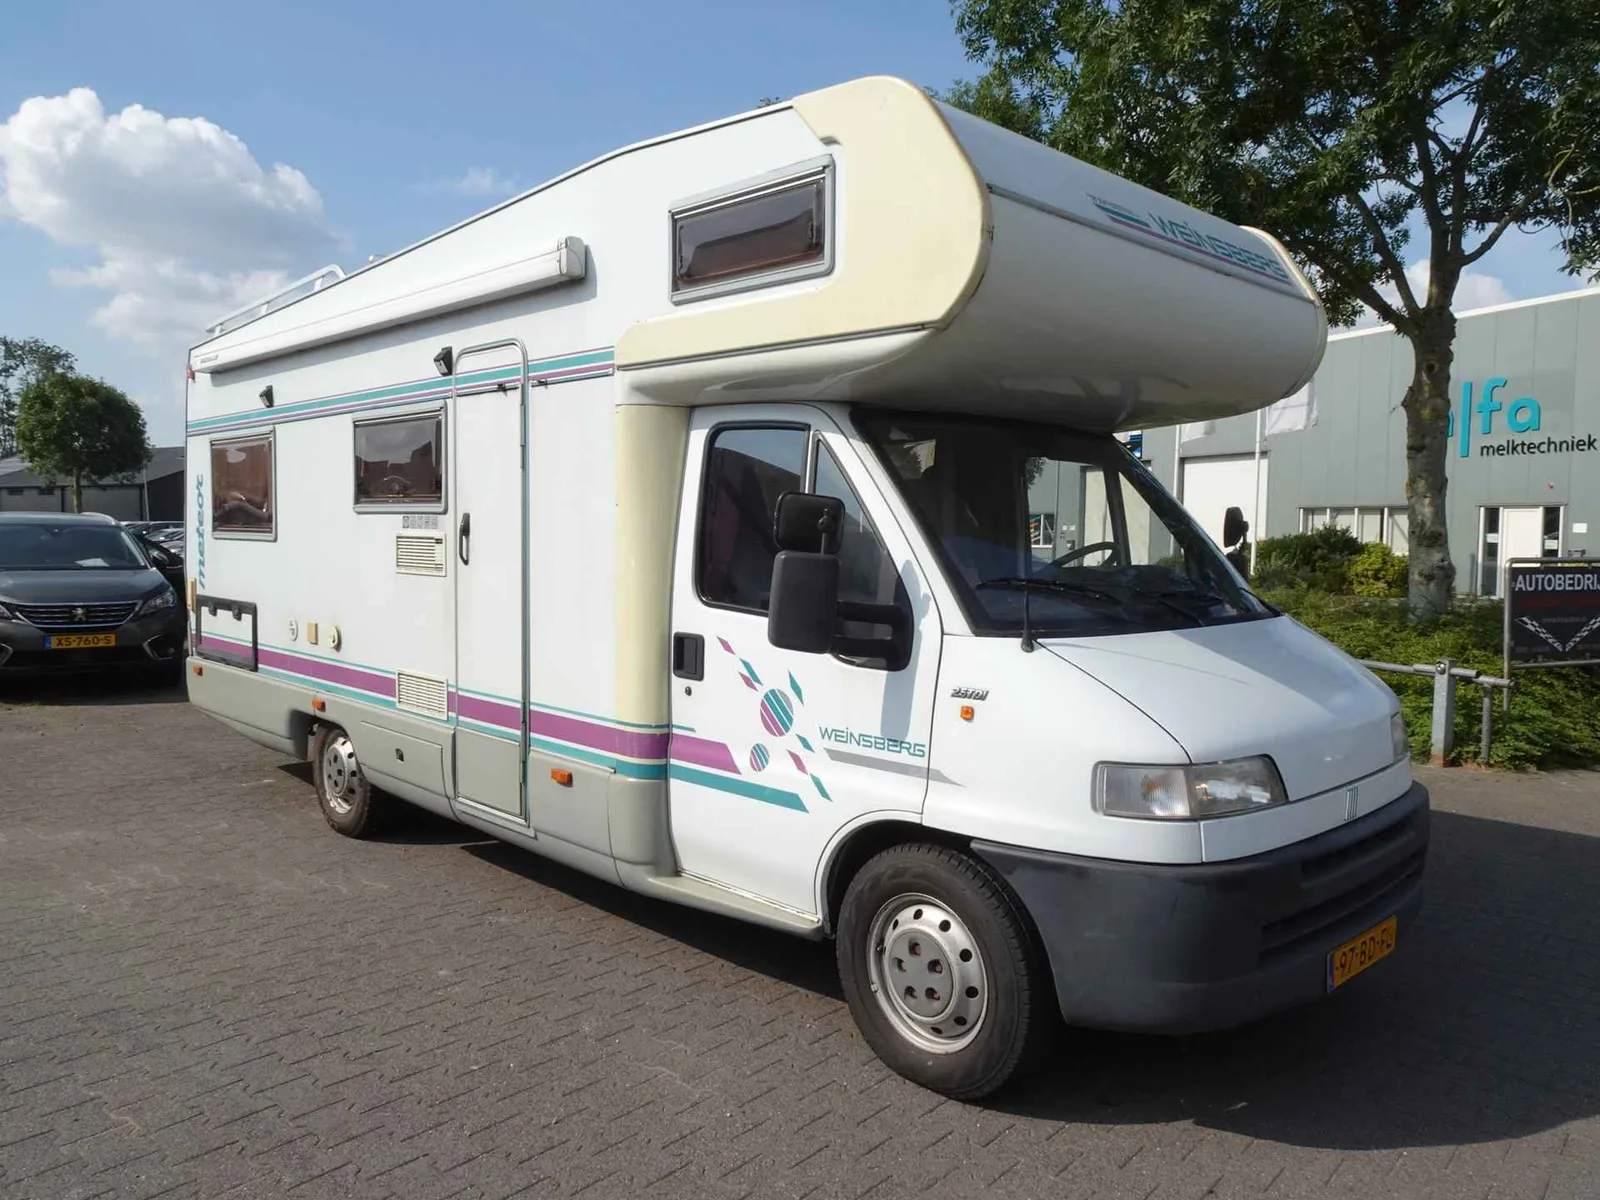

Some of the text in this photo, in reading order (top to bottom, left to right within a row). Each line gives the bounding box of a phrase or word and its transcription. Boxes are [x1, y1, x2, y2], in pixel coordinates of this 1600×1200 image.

[1480, 433, 1598, 457] melktechniek
[196, 474, 205, 590] meteor
[1514, 573, 1600, 592] AUTOBEDRI
[55, 635, 113, 647] XS-760-S
